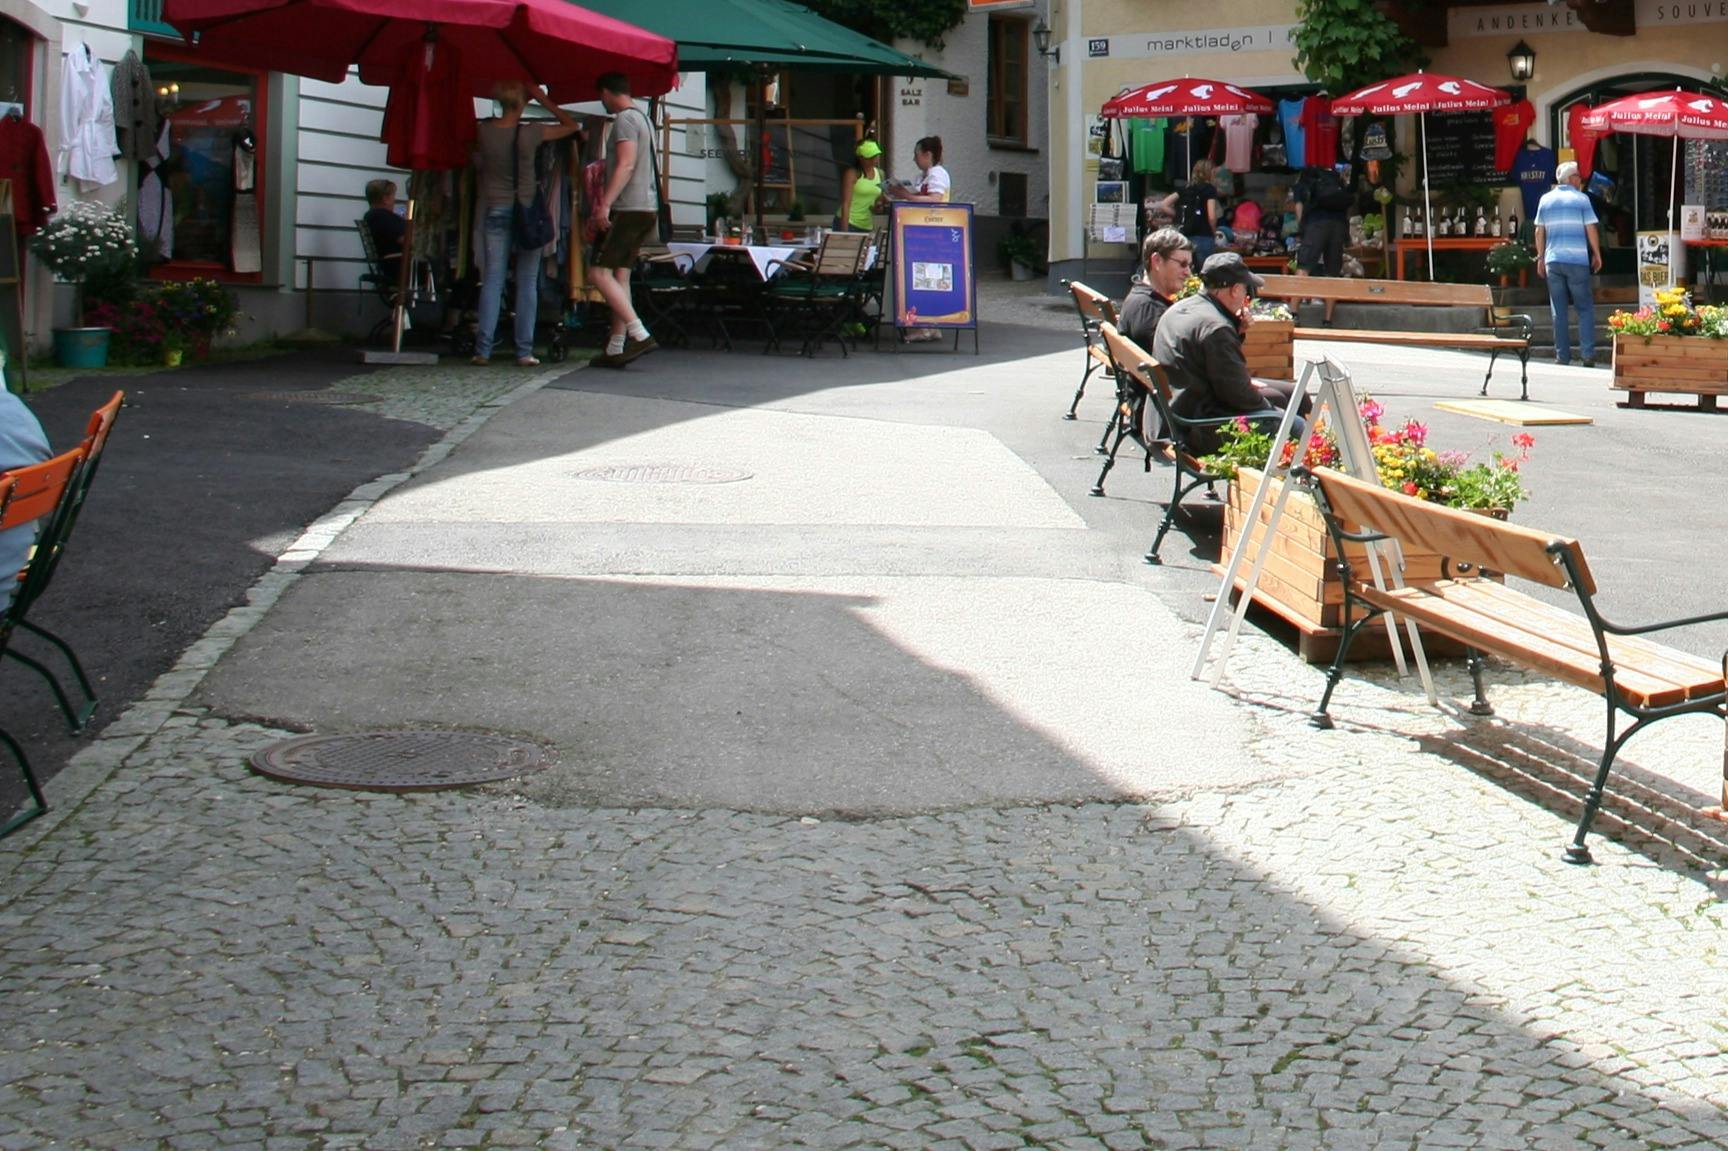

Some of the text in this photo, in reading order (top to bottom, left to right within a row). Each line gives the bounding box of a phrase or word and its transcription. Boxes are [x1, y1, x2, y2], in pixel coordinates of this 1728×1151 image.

[1476, 11, 1576, 33] ANDENKE
[1091, 40, 1106, 51] 159
[1146, 33, 1254, 52] marktladen
[900, 89, 923, 97] SALZ
[902, 98, 921, 106] BAR
[1122, 105, 1149, 114] Julius
[1150, 105, 1174, 113] Meinl
[1182, 103, 1239, 113] Julius Meinl
[1371, 103, 1430, 114] Julius Meinl
[1611, 111, 1641, 121] Julius
[1644, 112, 1672, 121] Meinl
[1681, 115, 1711, 127] Julius
